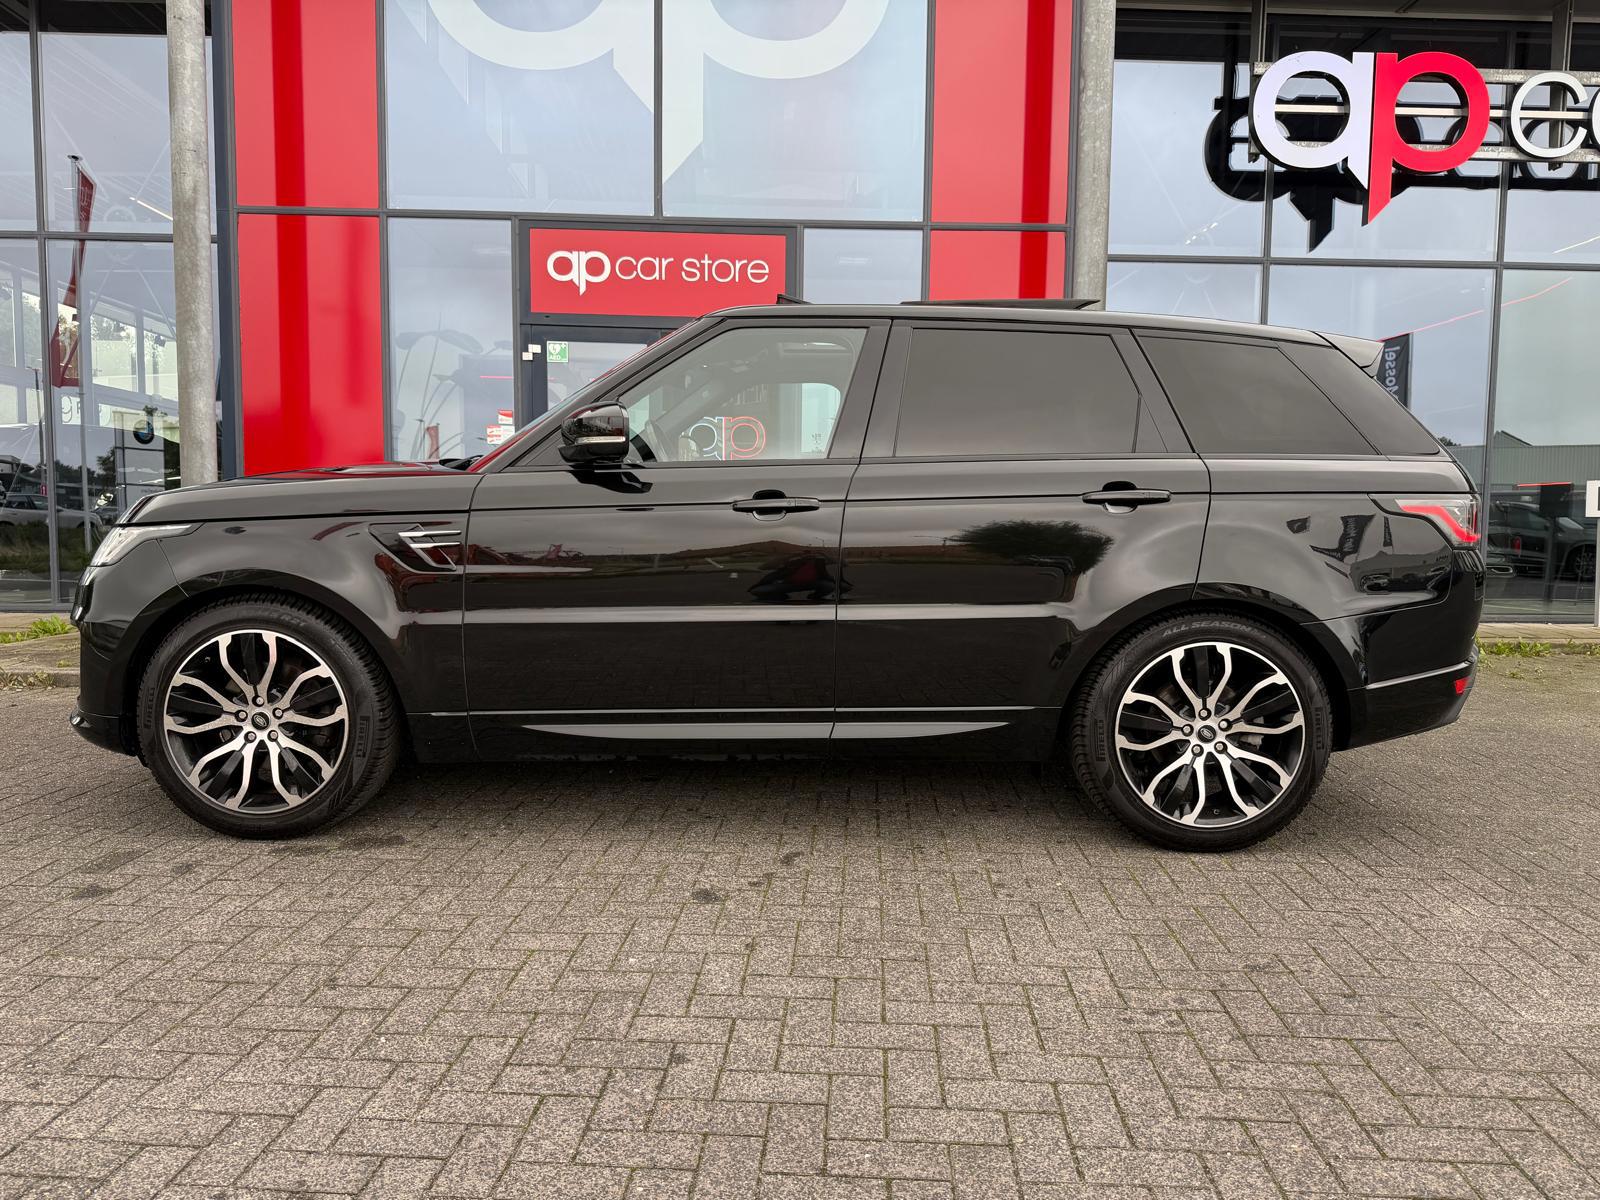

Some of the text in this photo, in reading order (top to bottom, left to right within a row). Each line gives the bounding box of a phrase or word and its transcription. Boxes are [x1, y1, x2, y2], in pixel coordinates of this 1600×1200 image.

[1252, 50, 1600, 225] ap c
[546, 250, 770, 297] ap car store
[1162, 620, 1252, 638] ALL SEASON
[1096, 719, 1105, 762] PIRELLI
